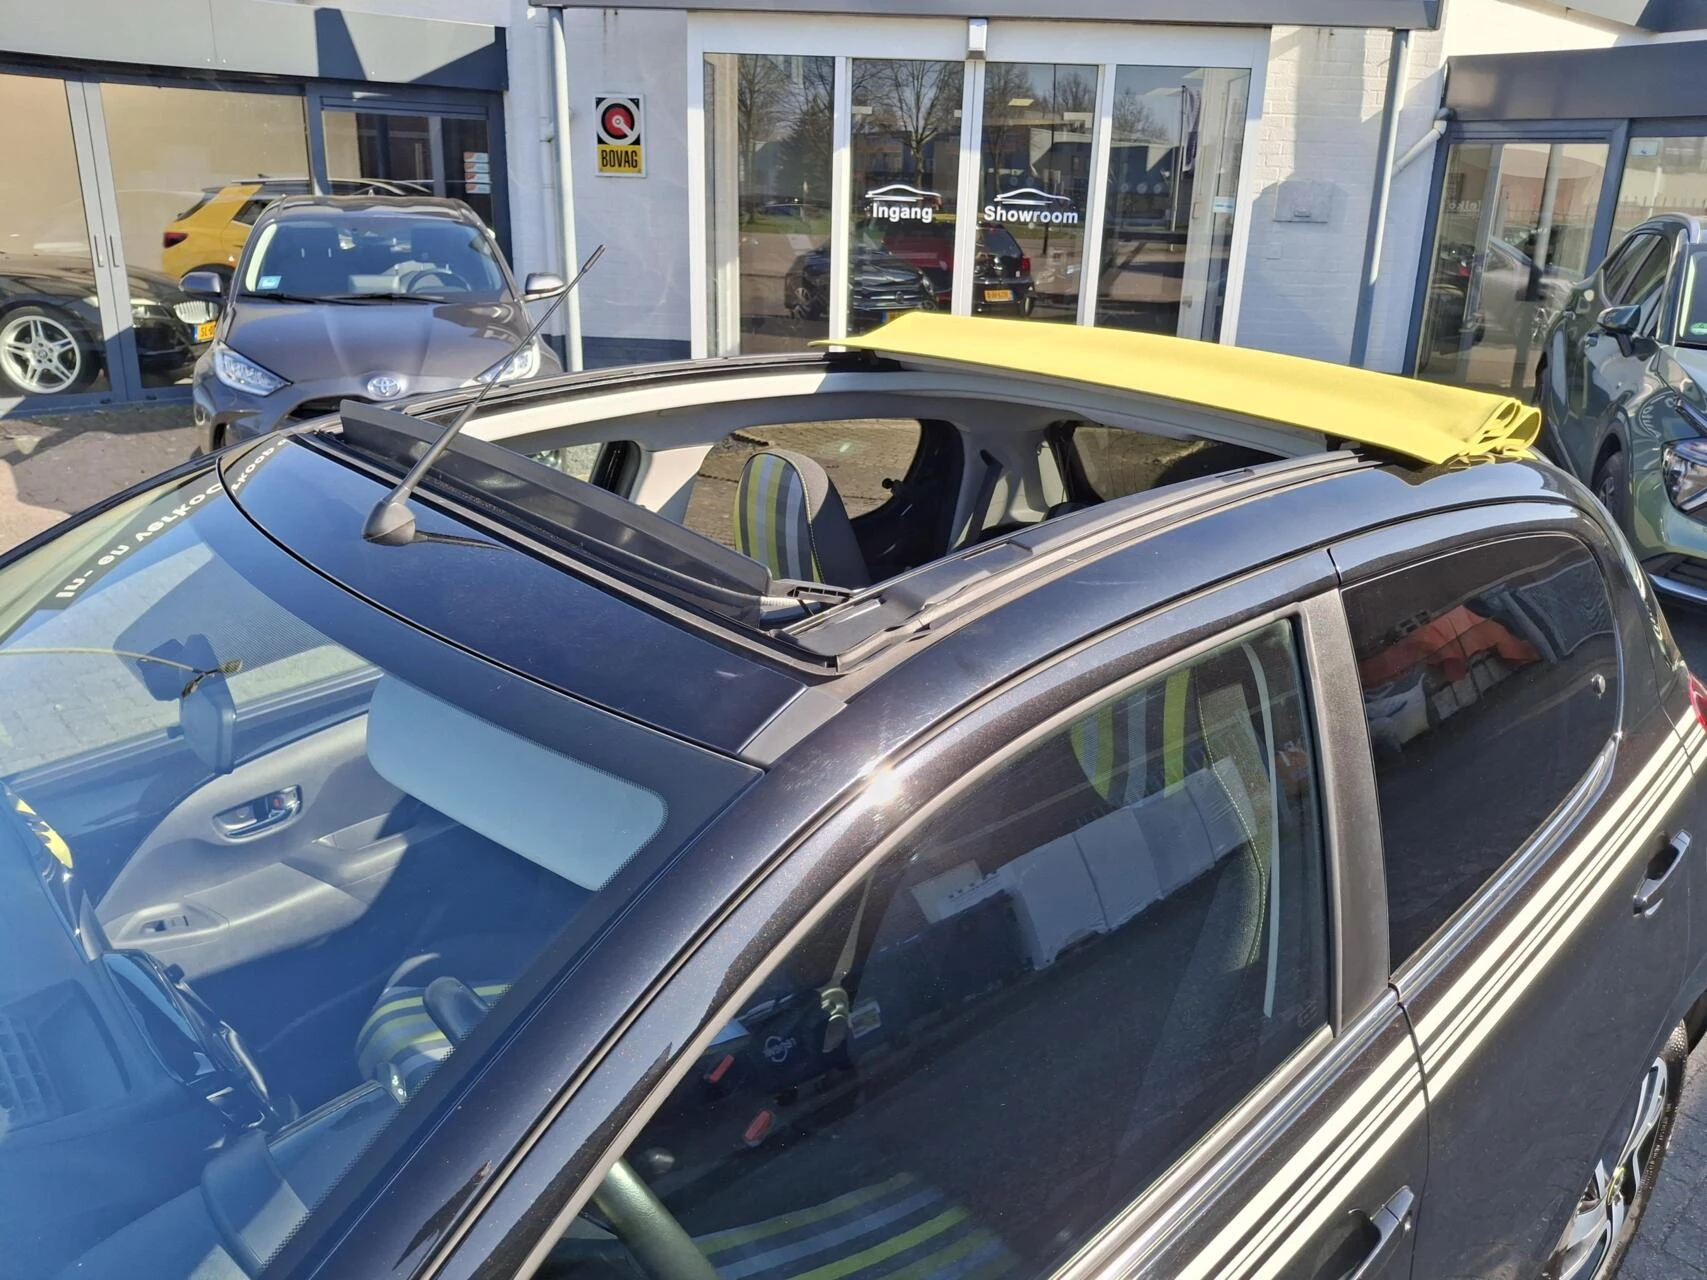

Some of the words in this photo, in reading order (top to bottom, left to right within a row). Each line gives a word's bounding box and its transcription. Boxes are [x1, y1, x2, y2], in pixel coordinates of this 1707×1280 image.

[601, 149, 638, 168] BOVAG
[873, 203, 933, 223] Ingang
[984, 206, 1078, 224] Showroom
